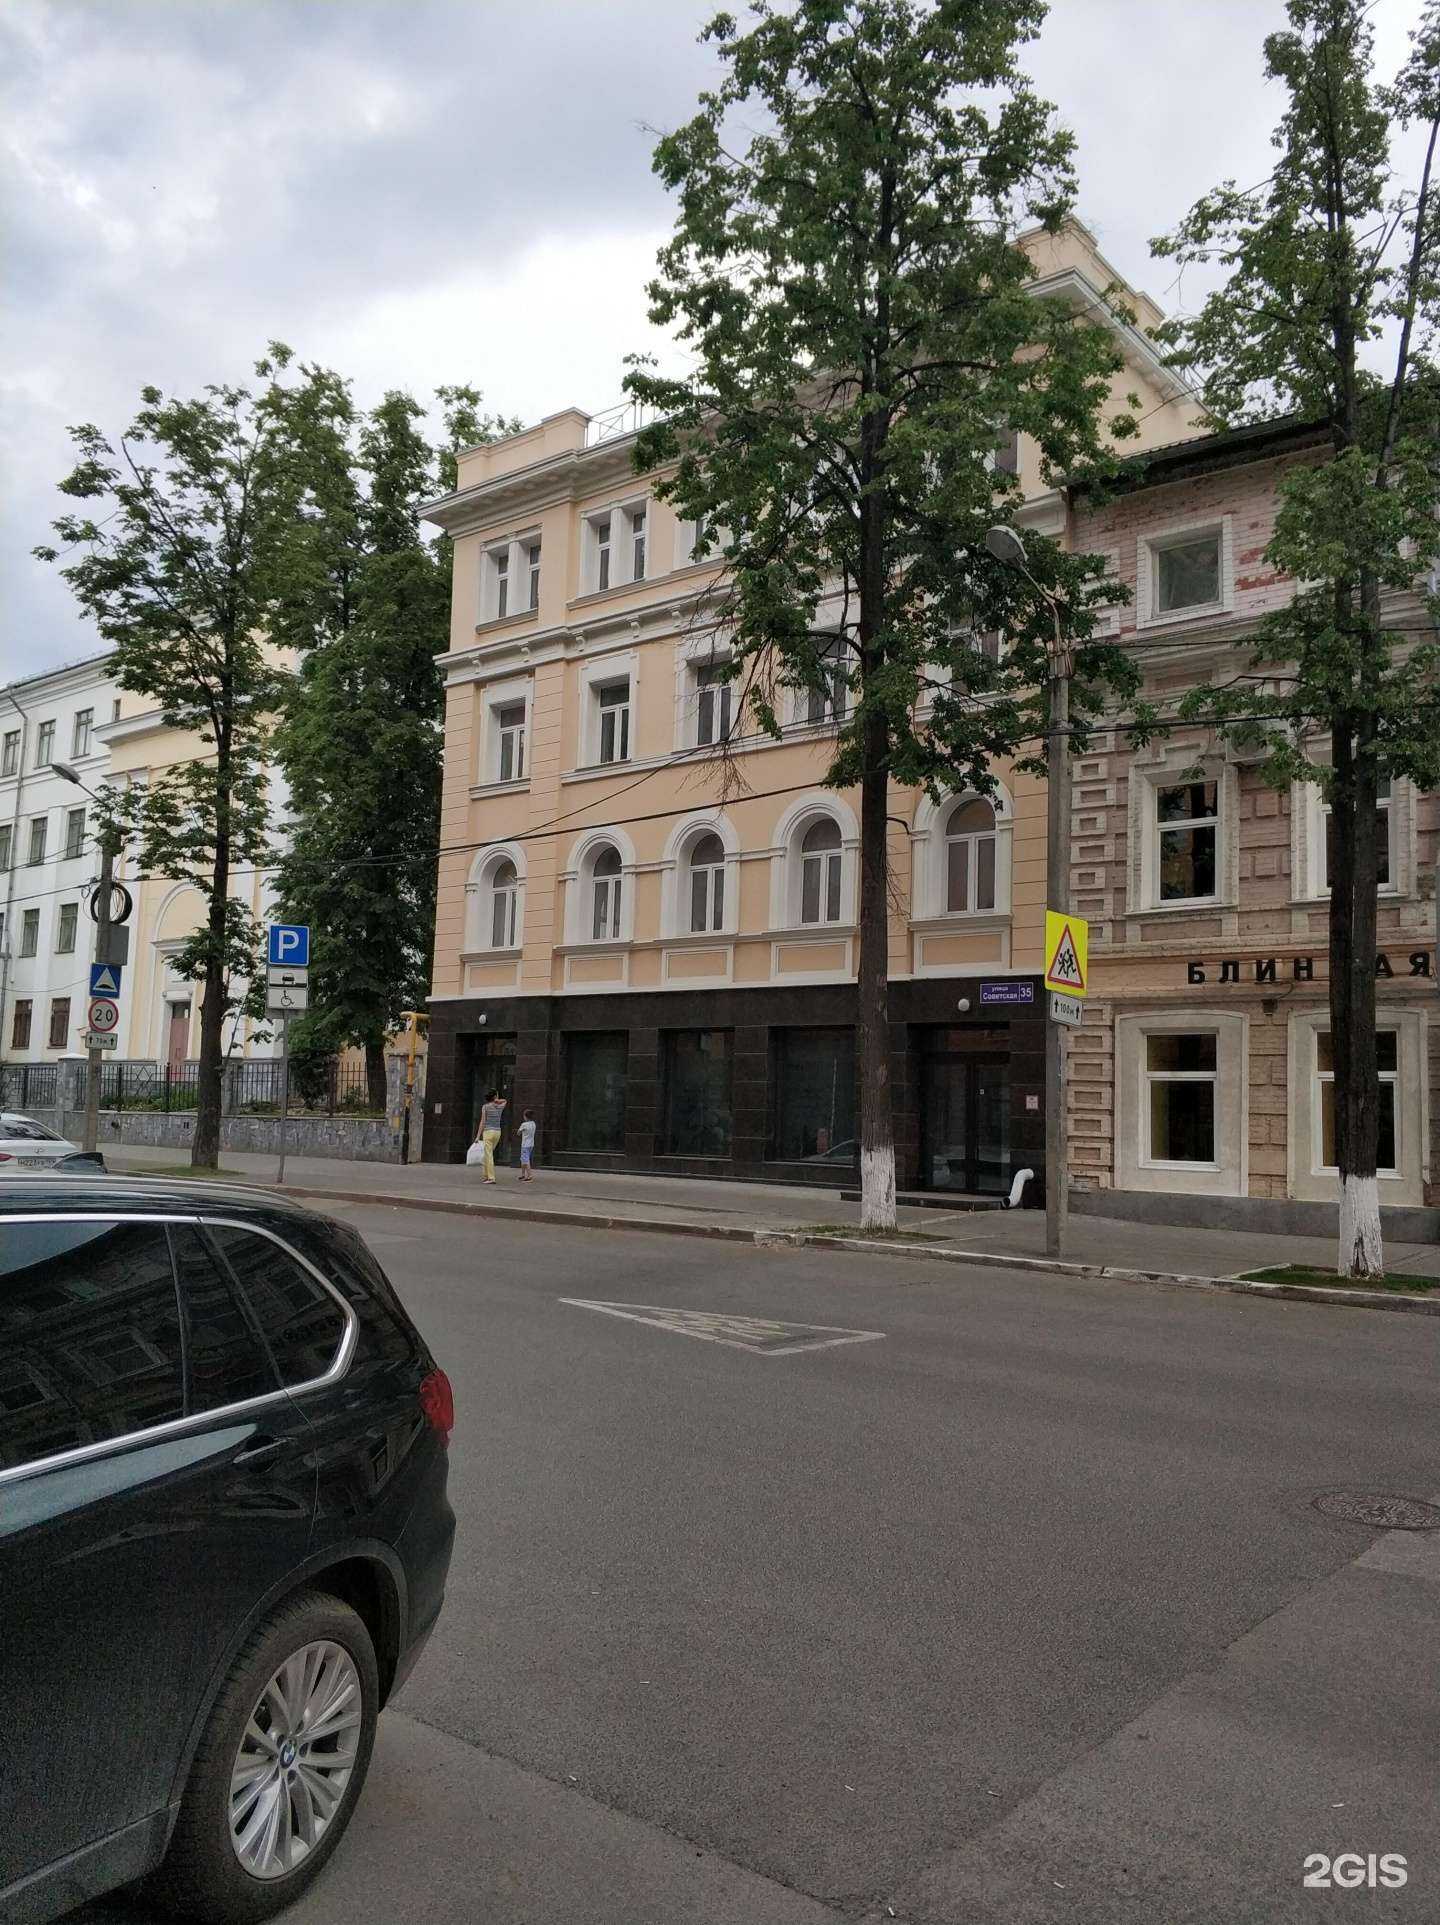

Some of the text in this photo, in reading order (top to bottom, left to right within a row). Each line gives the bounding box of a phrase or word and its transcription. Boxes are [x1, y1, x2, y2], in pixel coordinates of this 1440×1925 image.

[278, 930, 300, 960] P
[1188, 951, 1431, 984] БЛИНАЯ
[983, 992, 1018, 1000] Советская
[1021, 987, 1032, 998] 35
[94, 1009, 113, 1022] 20
